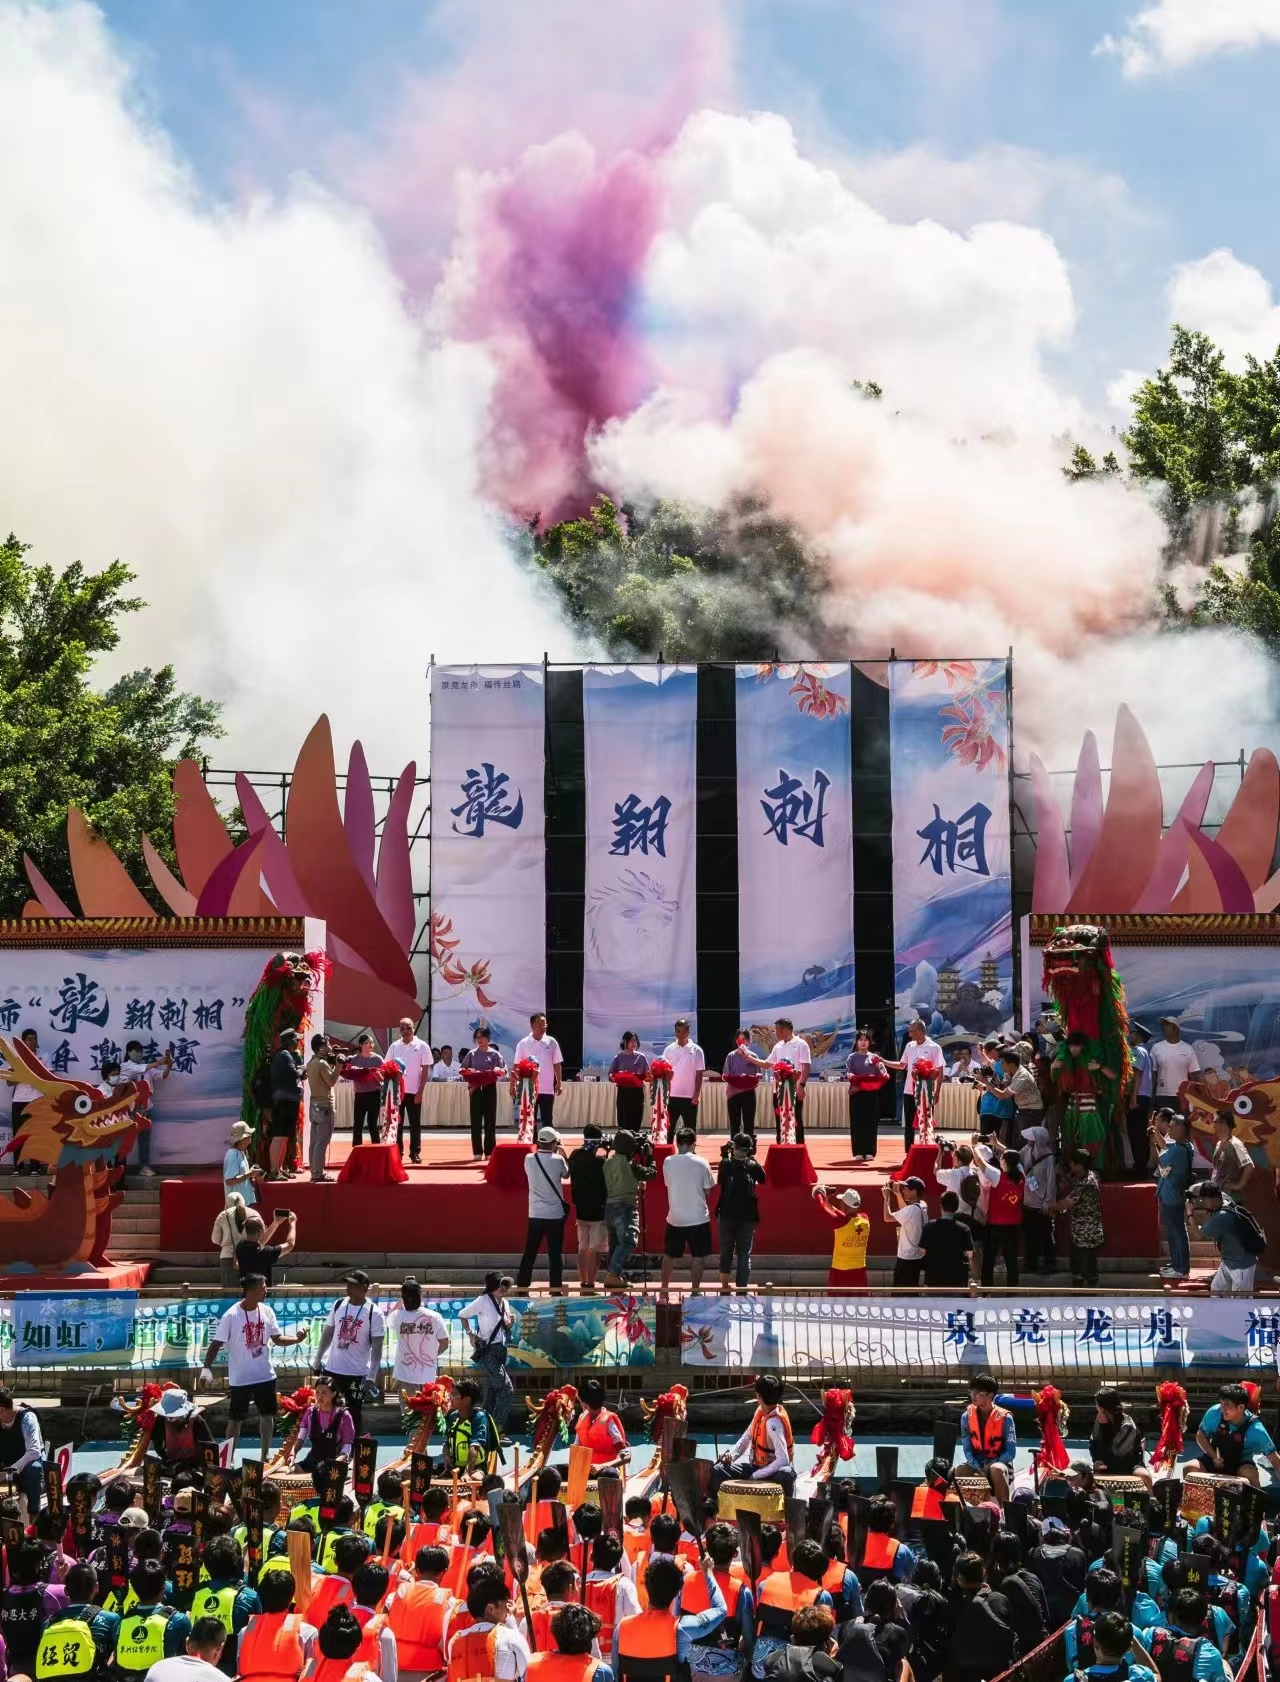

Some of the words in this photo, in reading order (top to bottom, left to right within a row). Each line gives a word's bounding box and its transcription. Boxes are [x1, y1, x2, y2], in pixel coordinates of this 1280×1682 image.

[450, 762, 523, 838] 龍
[608, 793, 672, 858] 翔
[760, 768, 830, 848] 刺
[916, 802, 992, 876] 桐
[944, 1308, 1181, 1346] 泉竞龙舟
[41, 1642, 81, 1668] 经贸
